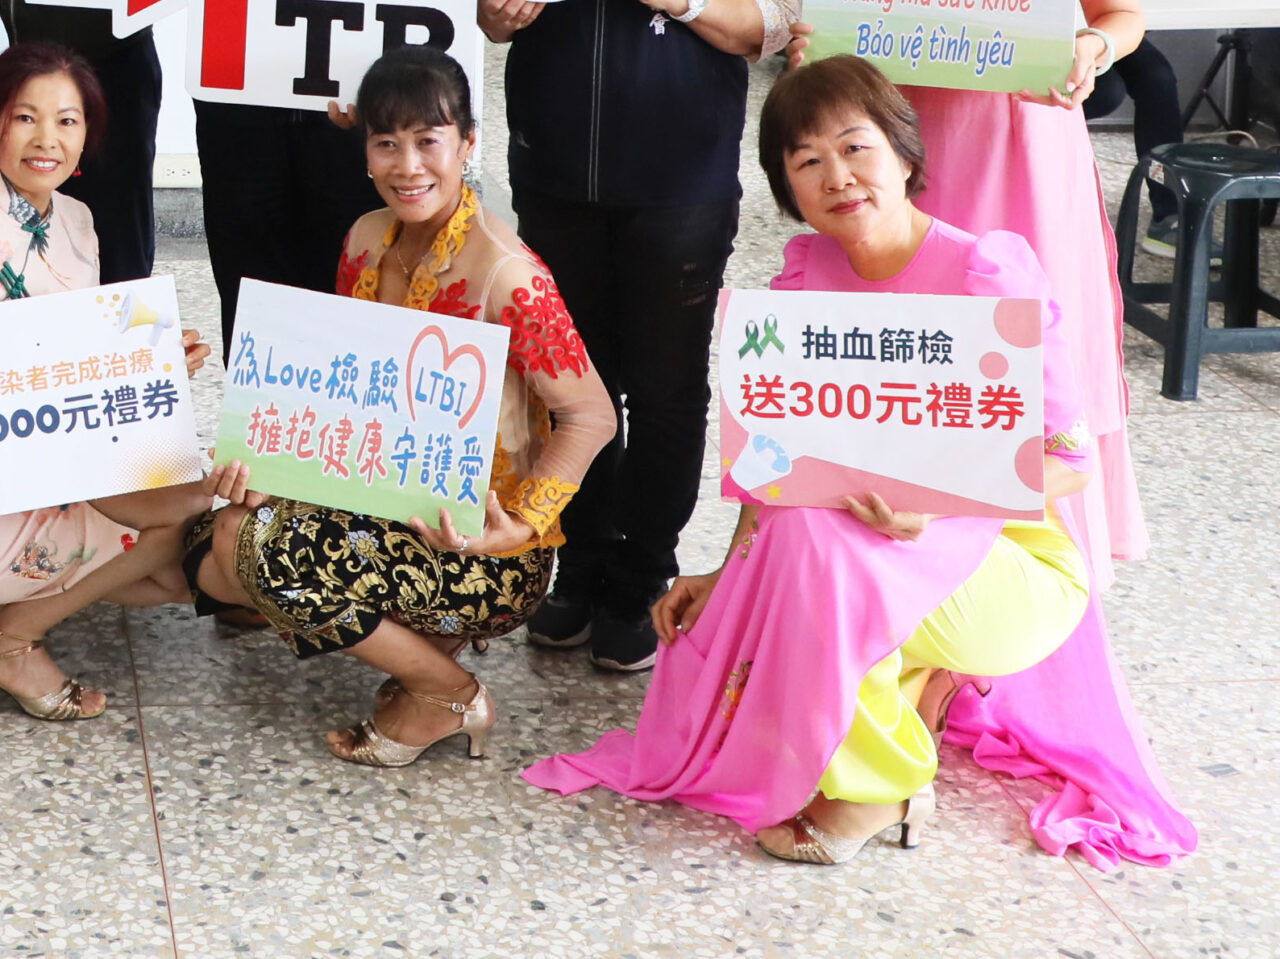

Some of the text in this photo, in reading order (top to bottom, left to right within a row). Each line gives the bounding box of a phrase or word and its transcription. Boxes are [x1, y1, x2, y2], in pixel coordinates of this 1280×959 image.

[856, 20, 1015, 76] Bảo vệ tình yêu
[802, 325, 954, 365] 抽血篩檢
[414, 367, 467, 417] LTBI
[740, 374, 1025, 431] 送300元禮券
